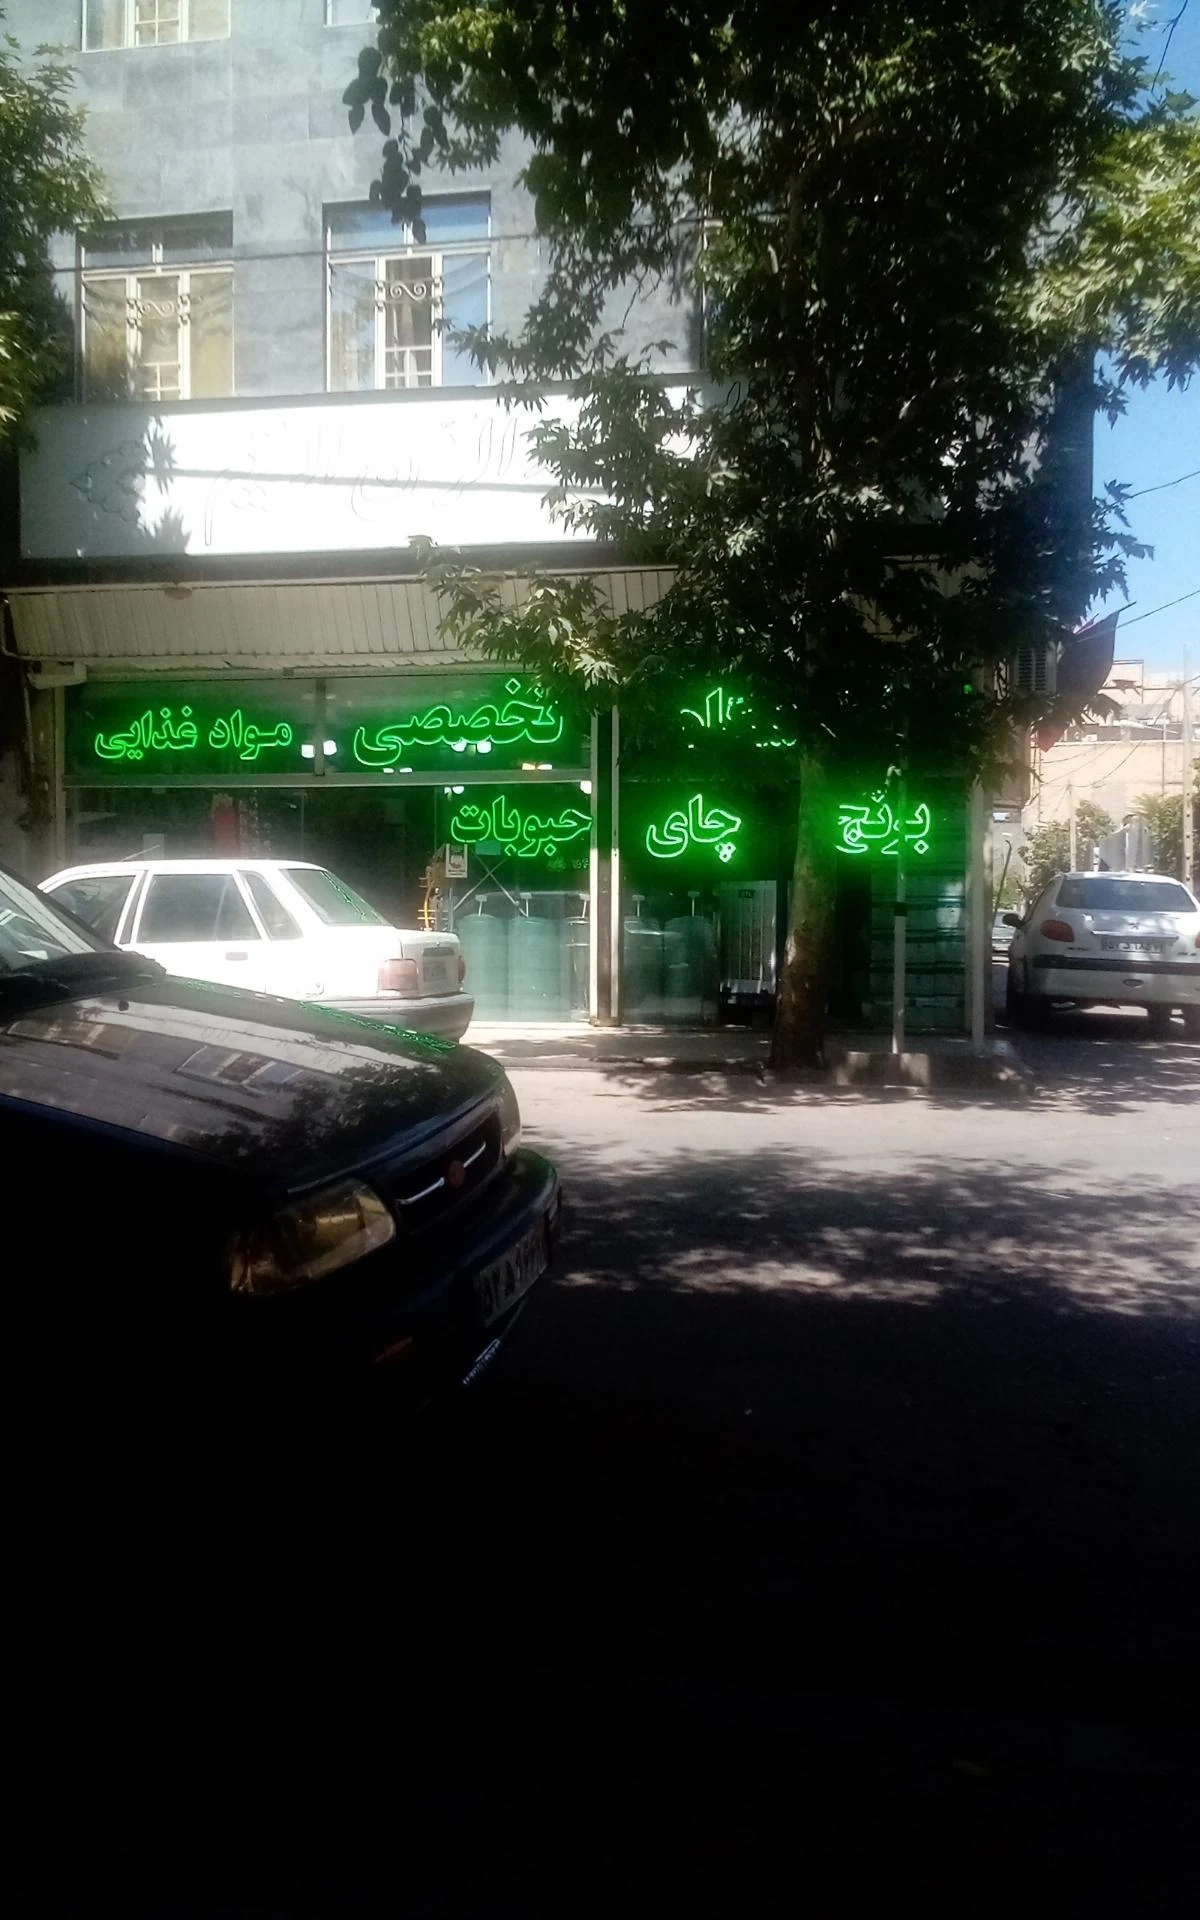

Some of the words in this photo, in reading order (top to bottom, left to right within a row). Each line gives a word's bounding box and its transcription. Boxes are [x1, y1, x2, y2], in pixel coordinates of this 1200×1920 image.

[94, 704, 199, 760] غذایی
[208, 708, 294, 761] مواد
[353, 677, 564, 767] تخصصی
[450, 794, 593, 858] حبوبات
[645, 793, 742, 863] چای
